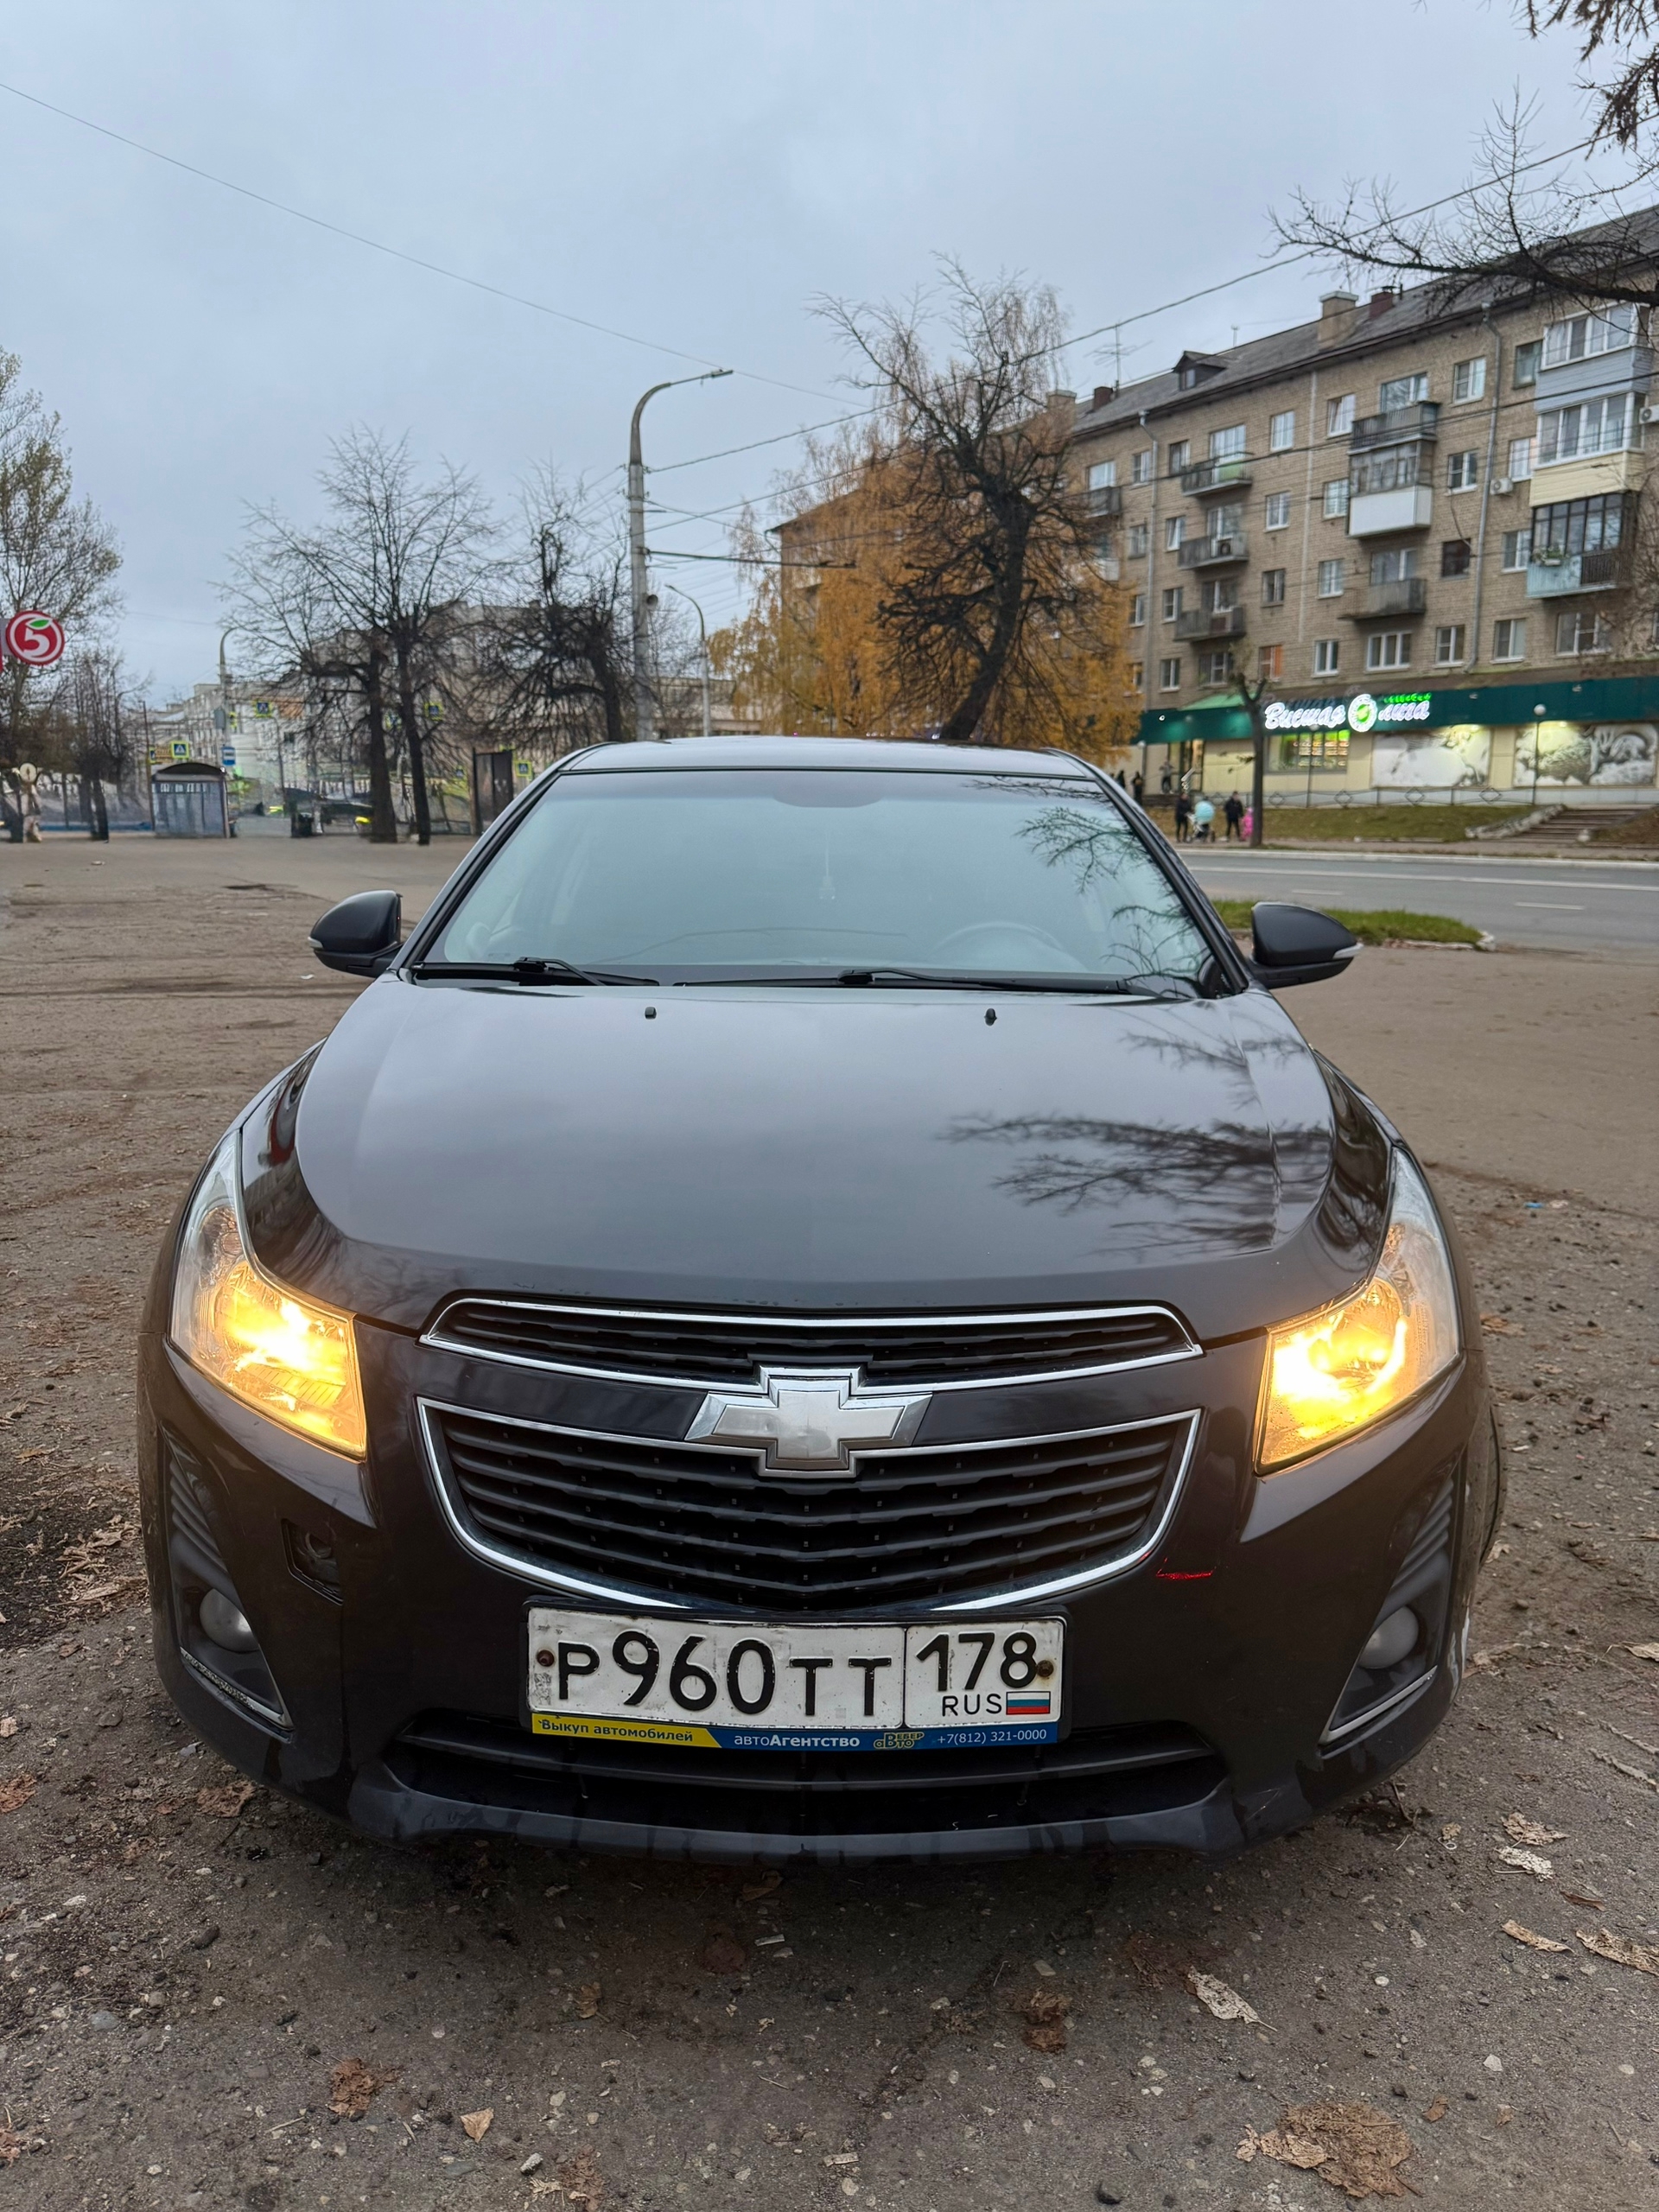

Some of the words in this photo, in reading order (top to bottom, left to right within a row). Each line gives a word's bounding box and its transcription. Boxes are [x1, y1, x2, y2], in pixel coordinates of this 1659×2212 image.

[916, 1631, 1038, 1692] 178
[942, 1694, 1002, 1717] RUS
[541, 1719, 589, 1735] Выкуп
[594, 1725, 693, 1742] автомобилей
[734, 1734, 861, 1748] автоАгентство
[938, 1732, 987, 1745] +7(812)
[990, 1729, 1047, 1742] 321-0000
